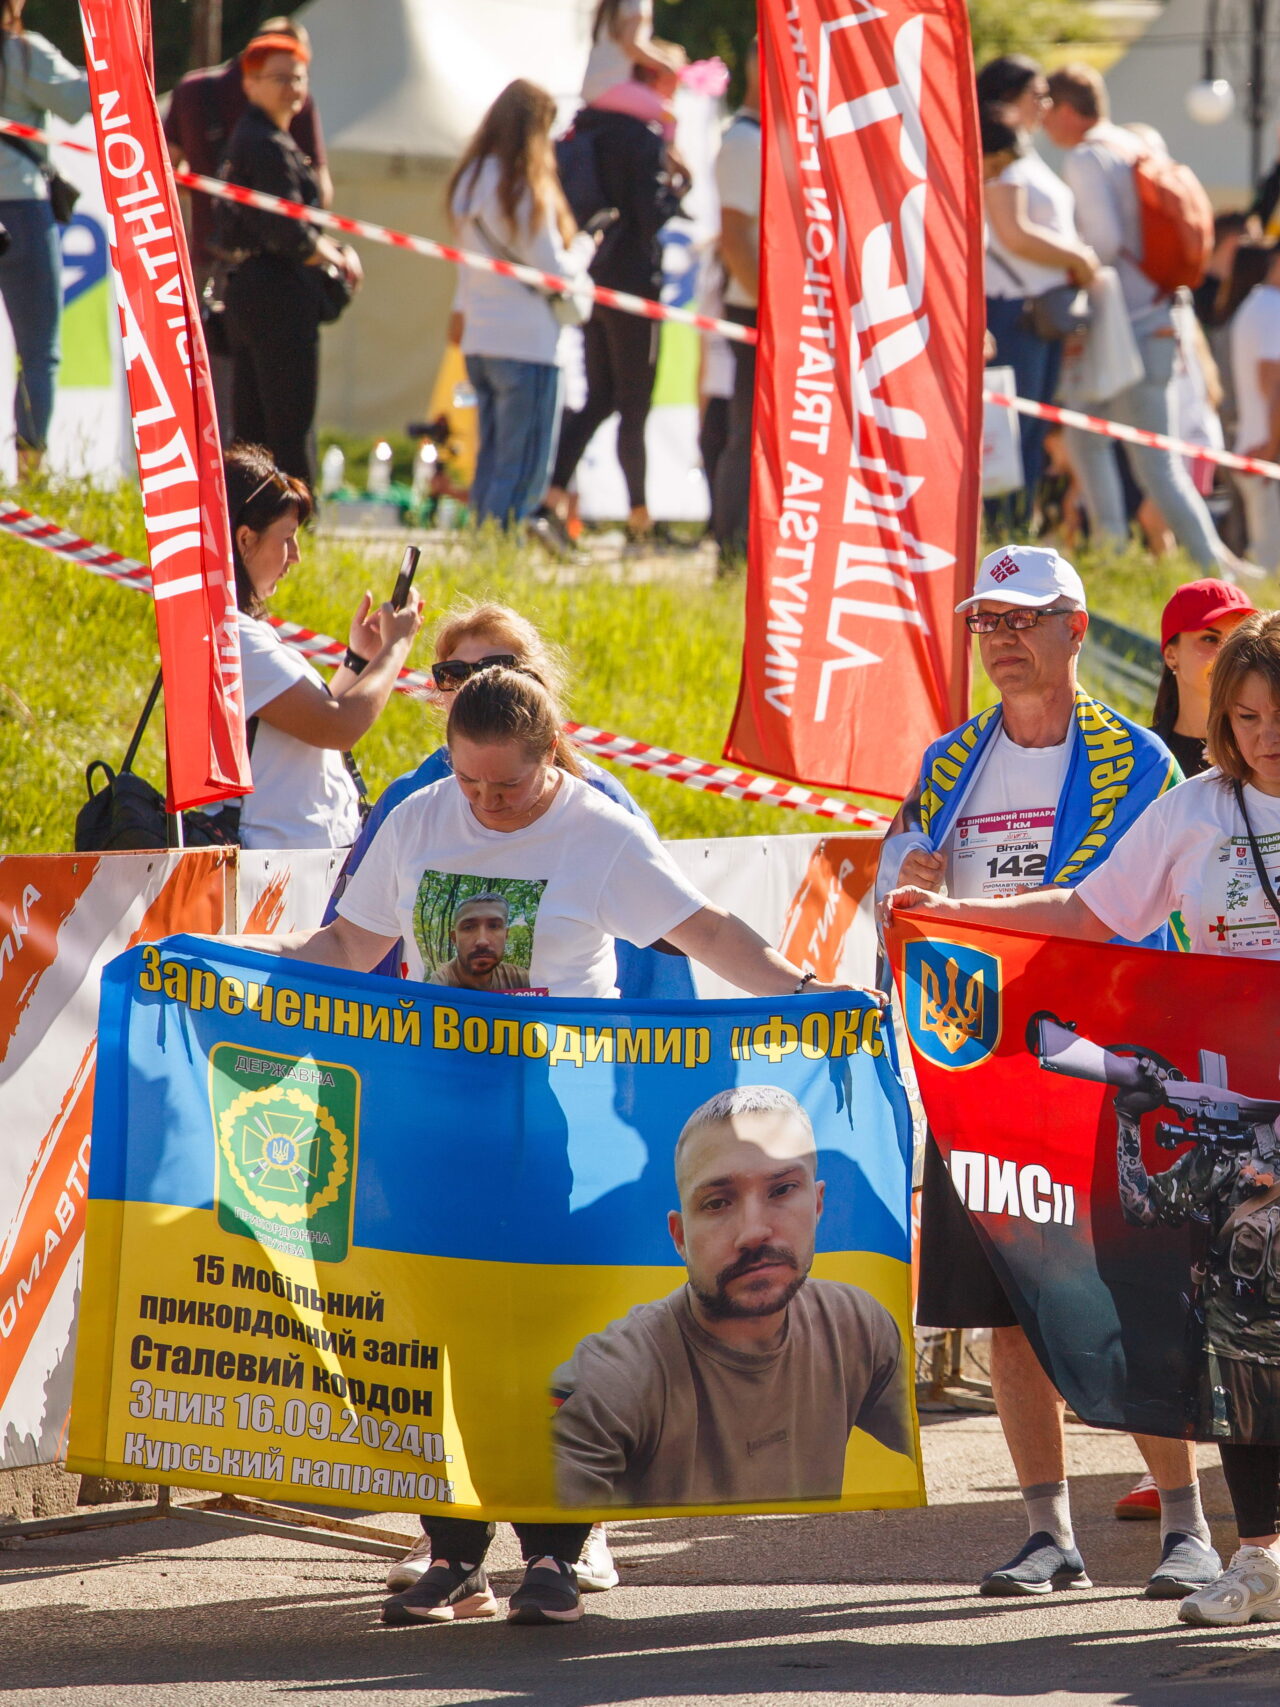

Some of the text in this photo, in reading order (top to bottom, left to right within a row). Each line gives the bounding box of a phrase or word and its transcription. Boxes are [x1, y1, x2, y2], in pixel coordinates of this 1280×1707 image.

[986, 854, 1048, 878] 142
[996, 841, 1039, 853] Віталій
[139, 945, 421, 1047] Зареченний
[433, 1003, 711, 1069] Володимир
[235, 1055, 335, 1088] ДЕРЖАВНА
[942, 1150, 1074, 1226] ПИС»
[234, 1206, 331, 1245] ПРИКОРДОННА
[254, 1231, 306, 1258] СЛУЖБА
[193, 1253, 385, 1322] 15 мобільний
[139, 1294, 439, 1370] прикордонний загін
[130, 1334, 433, 1417] Сталевий кордон
[128, 1379, 454, 1464] Зник 16.09.2024р.
[122, 1431, 456, 1504] Курський напрямок
